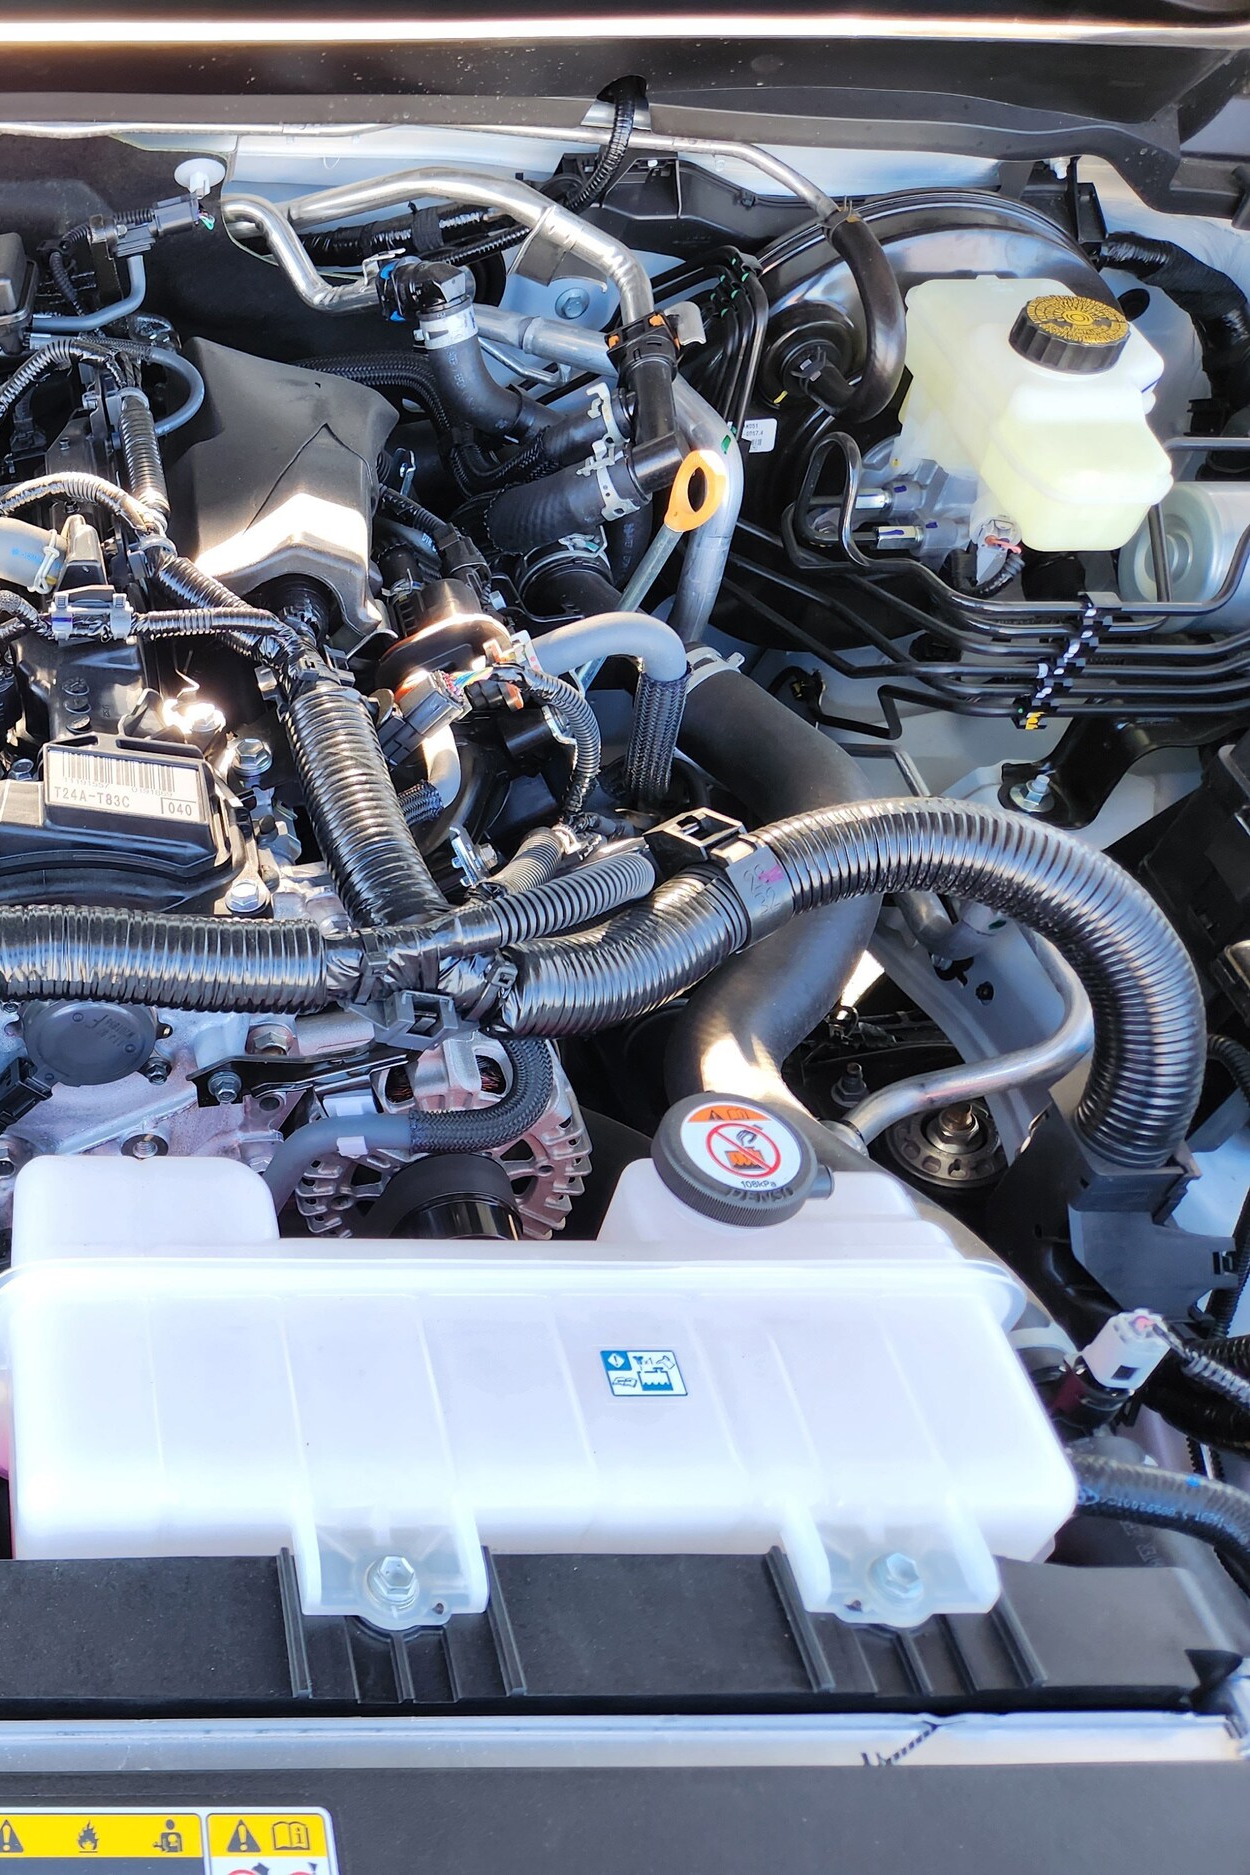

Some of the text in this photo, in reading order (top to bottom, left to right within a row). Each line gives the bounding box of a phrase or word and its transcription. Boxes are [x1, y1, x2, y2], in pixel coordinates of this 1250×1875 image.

[54, 786, 192, 817] T24A-T83C 040
[740, 1179, 777, 1189] 108kPa
